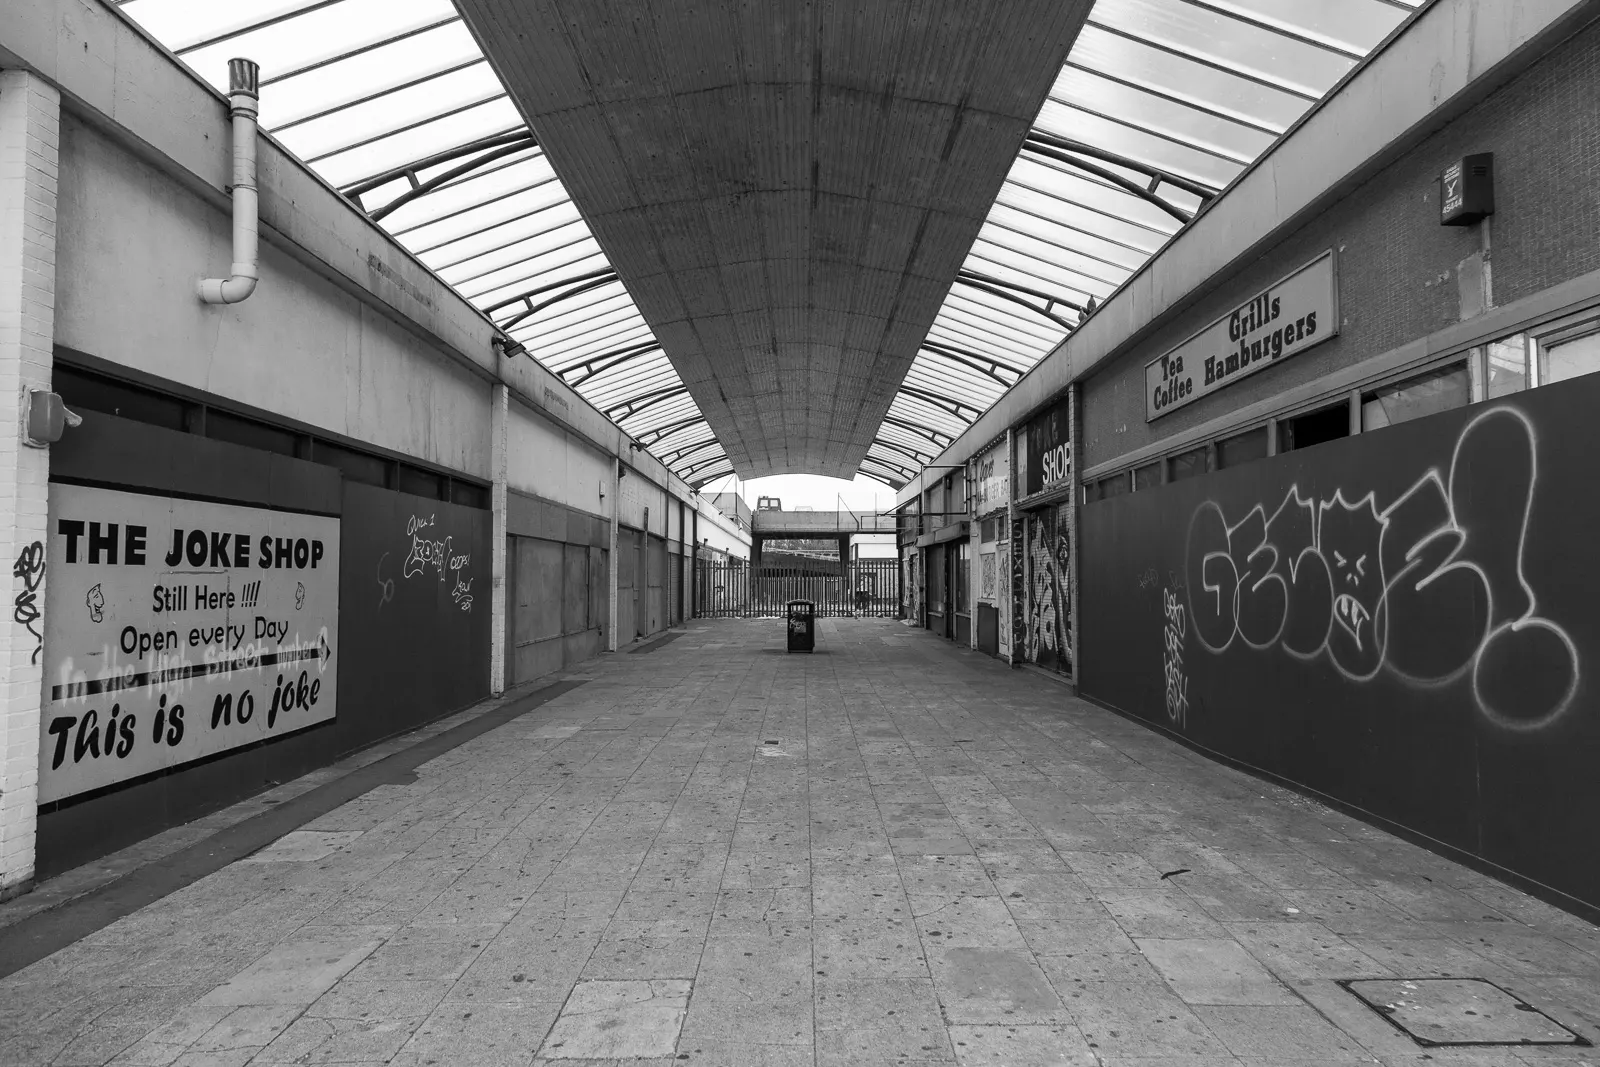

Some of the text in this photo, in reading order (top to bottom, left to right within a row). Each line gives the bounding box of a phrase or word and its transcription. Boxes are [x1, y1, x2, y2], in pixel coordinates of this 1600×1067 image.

[1229, 293, 1281, 342] Grills
[1161, 354, 1184, 382] Tea
[1204, 311, 1317, 386] Hamburgers
[1153, 376, 1193, 411] Coffee
[1042, 441, 1070, 485] SHOP
[58, 519, 324, 569] THE JOKE SHOP
[152, 580, 261, 613] Still Here !!!!
[120, 616, 289, 660] Open every Day
[49, 669, 321, 771] This is no joke
